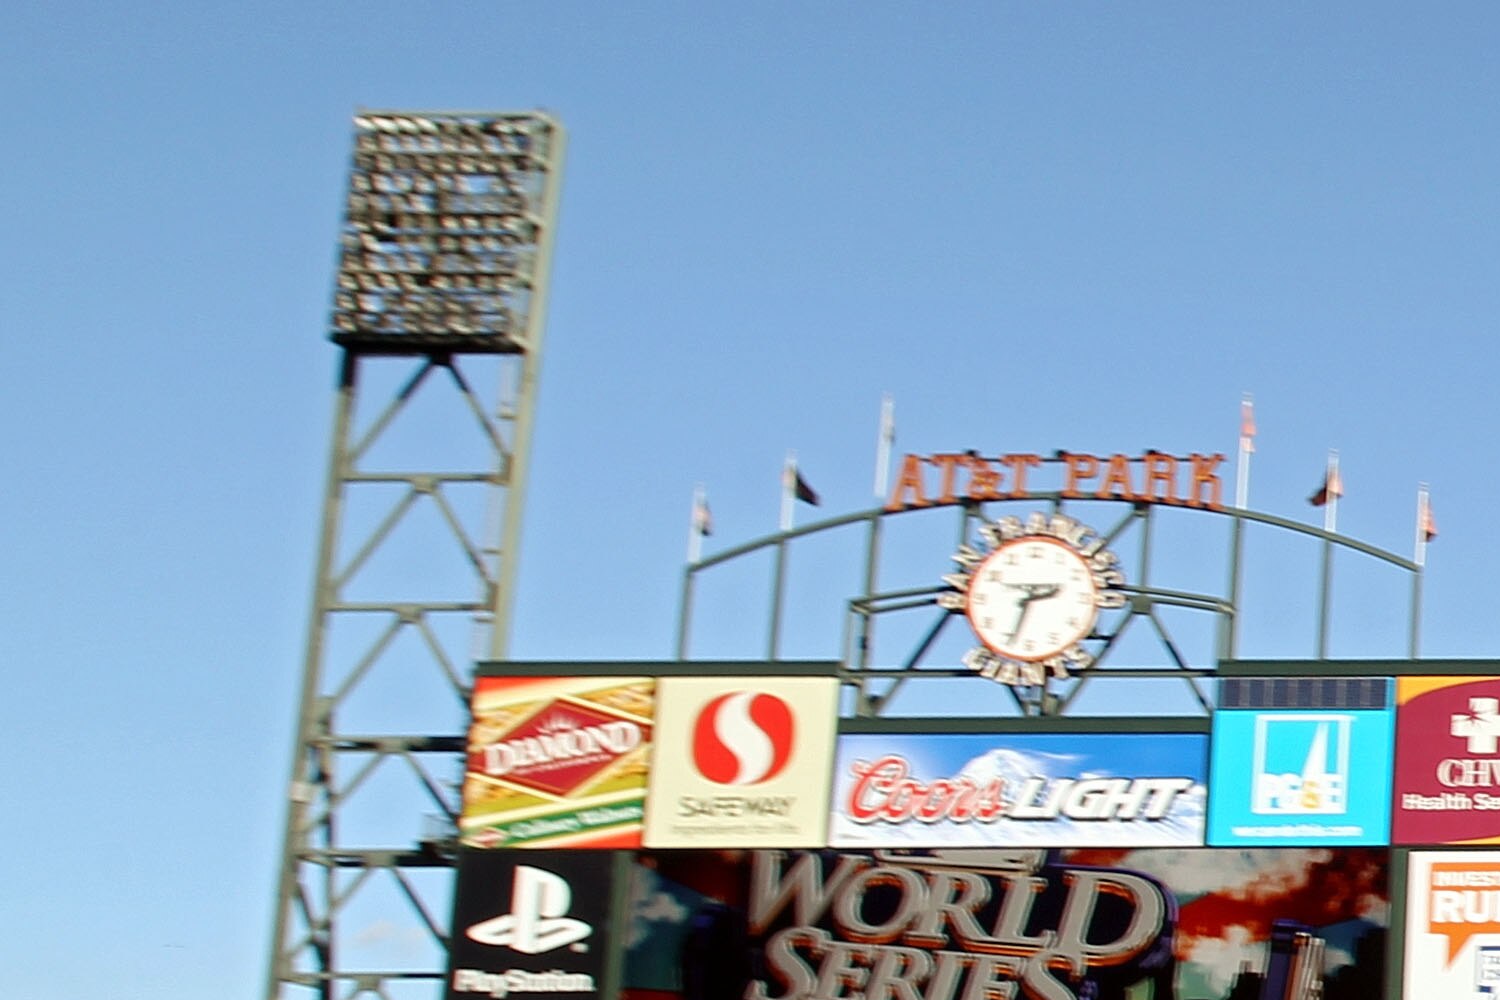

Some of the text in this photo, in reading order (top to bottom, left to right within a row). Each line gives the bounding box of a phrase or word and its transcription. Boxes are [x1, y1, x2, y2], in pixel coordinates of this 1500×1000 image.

[884, 453, 1226, 511] AT&T PARK
[678, 796, 797, 817] SAFEWAY
[847, 756, 1195, 824] Coors LIGHT
[1401, 792, 1472, 810] Health
[747, 849, 1167, 981] WORLD
[452, 968, 597, 999] PlayStation
